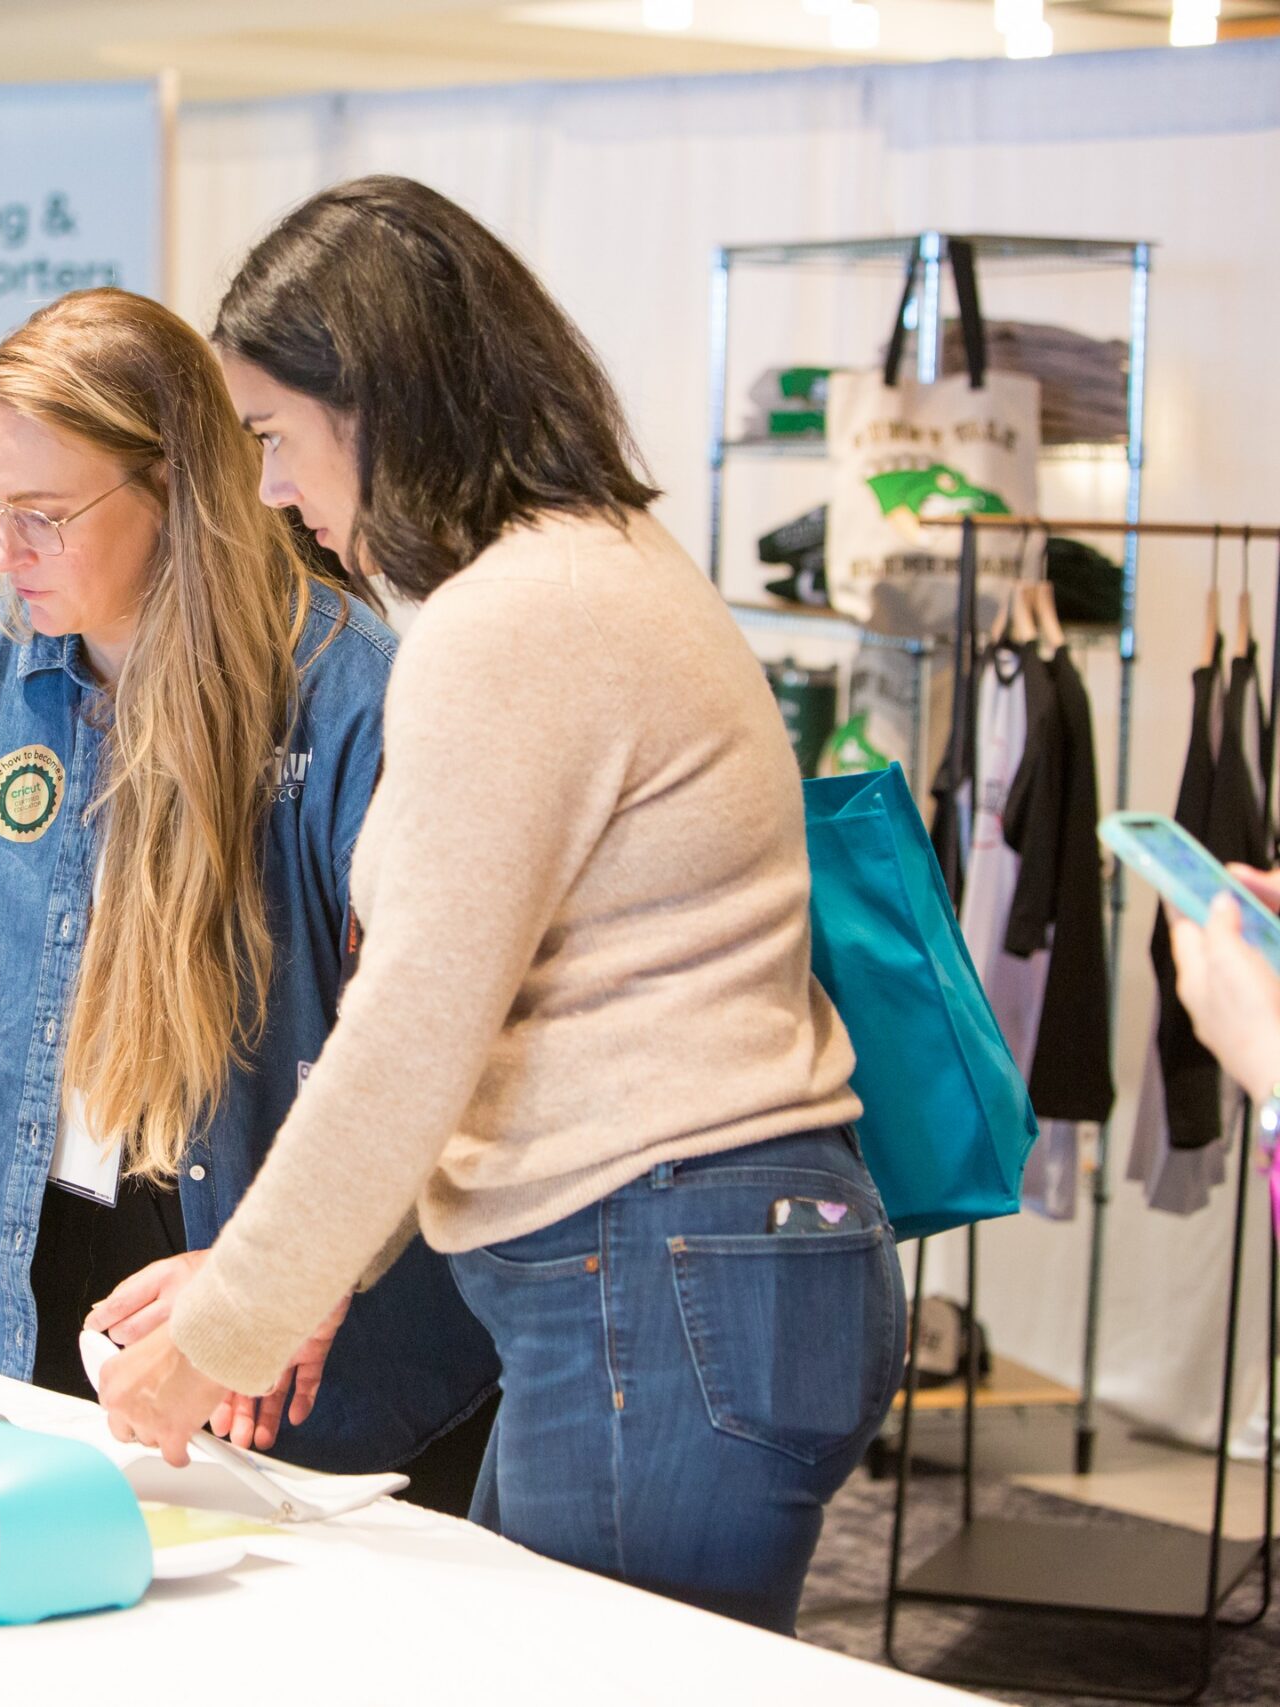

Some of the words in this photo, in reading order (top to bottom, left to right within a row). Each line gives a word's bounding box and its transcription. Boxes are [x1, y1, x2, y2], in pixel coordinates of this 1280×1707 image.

[44, 191, 76, 236] &
[2, 754, 22, 771] how
[23, 751, 33, 760] to
[33, 749, 61, 774] become
[11, 782, 41, 798] cricut
